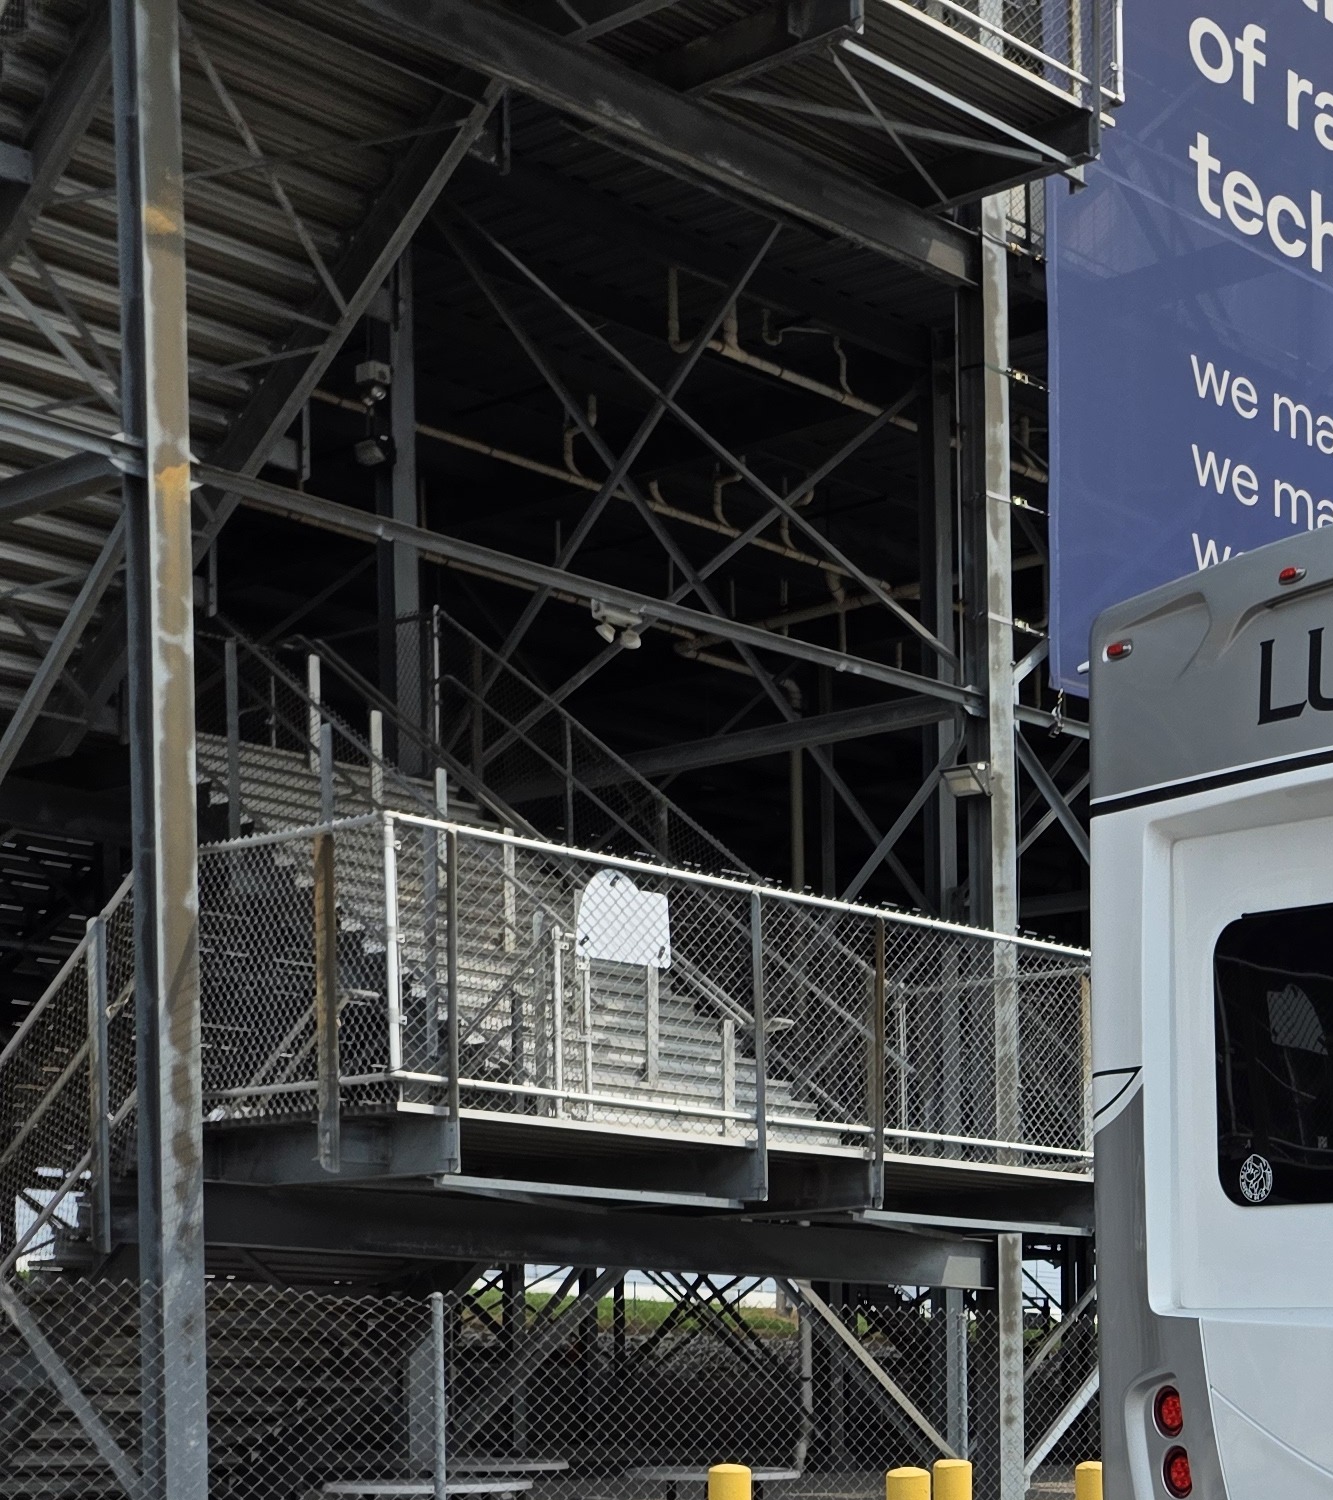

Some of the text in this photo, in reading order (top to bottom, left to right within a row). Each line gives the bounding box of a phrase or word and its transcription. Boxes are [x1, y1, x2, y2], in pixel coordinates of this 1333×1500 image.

[1188, 16, 1267, 105] of
[1190, 354, 1259, 420] we
[1191, 443, 1259, 507] we
